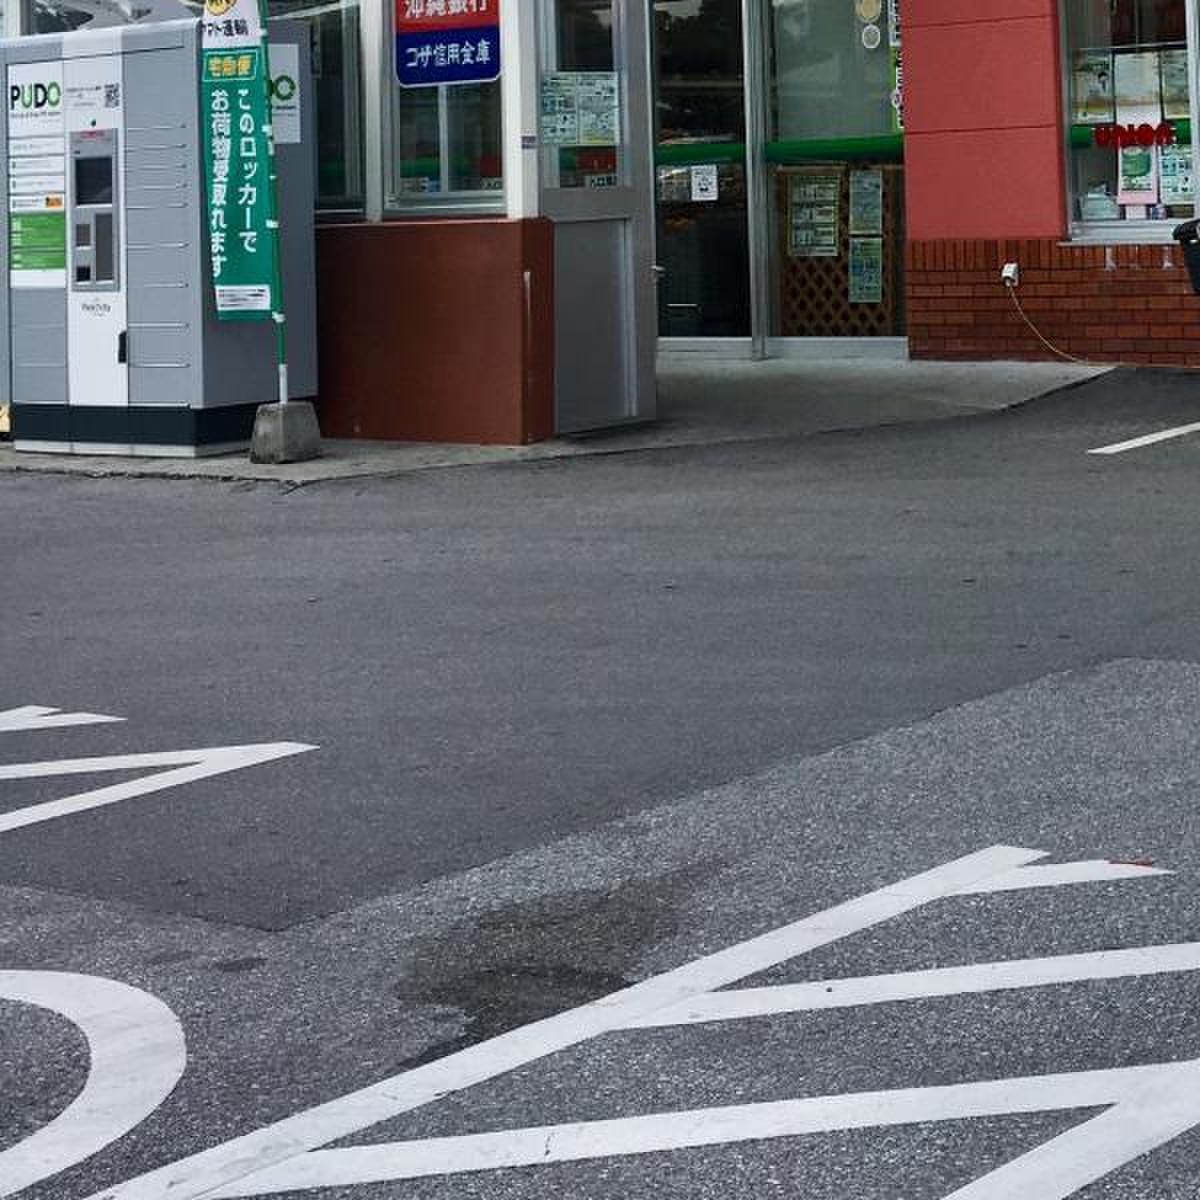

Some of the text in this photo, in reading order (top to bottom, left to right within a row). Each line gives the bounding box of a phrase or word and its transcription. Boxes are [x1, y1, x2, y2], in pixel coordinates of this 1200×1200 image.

[405, 38, 491, 67] コザ信用金庫
[10, 82, 61, 110] PUDO
[238, 88, 257, 253] このロッカーで
